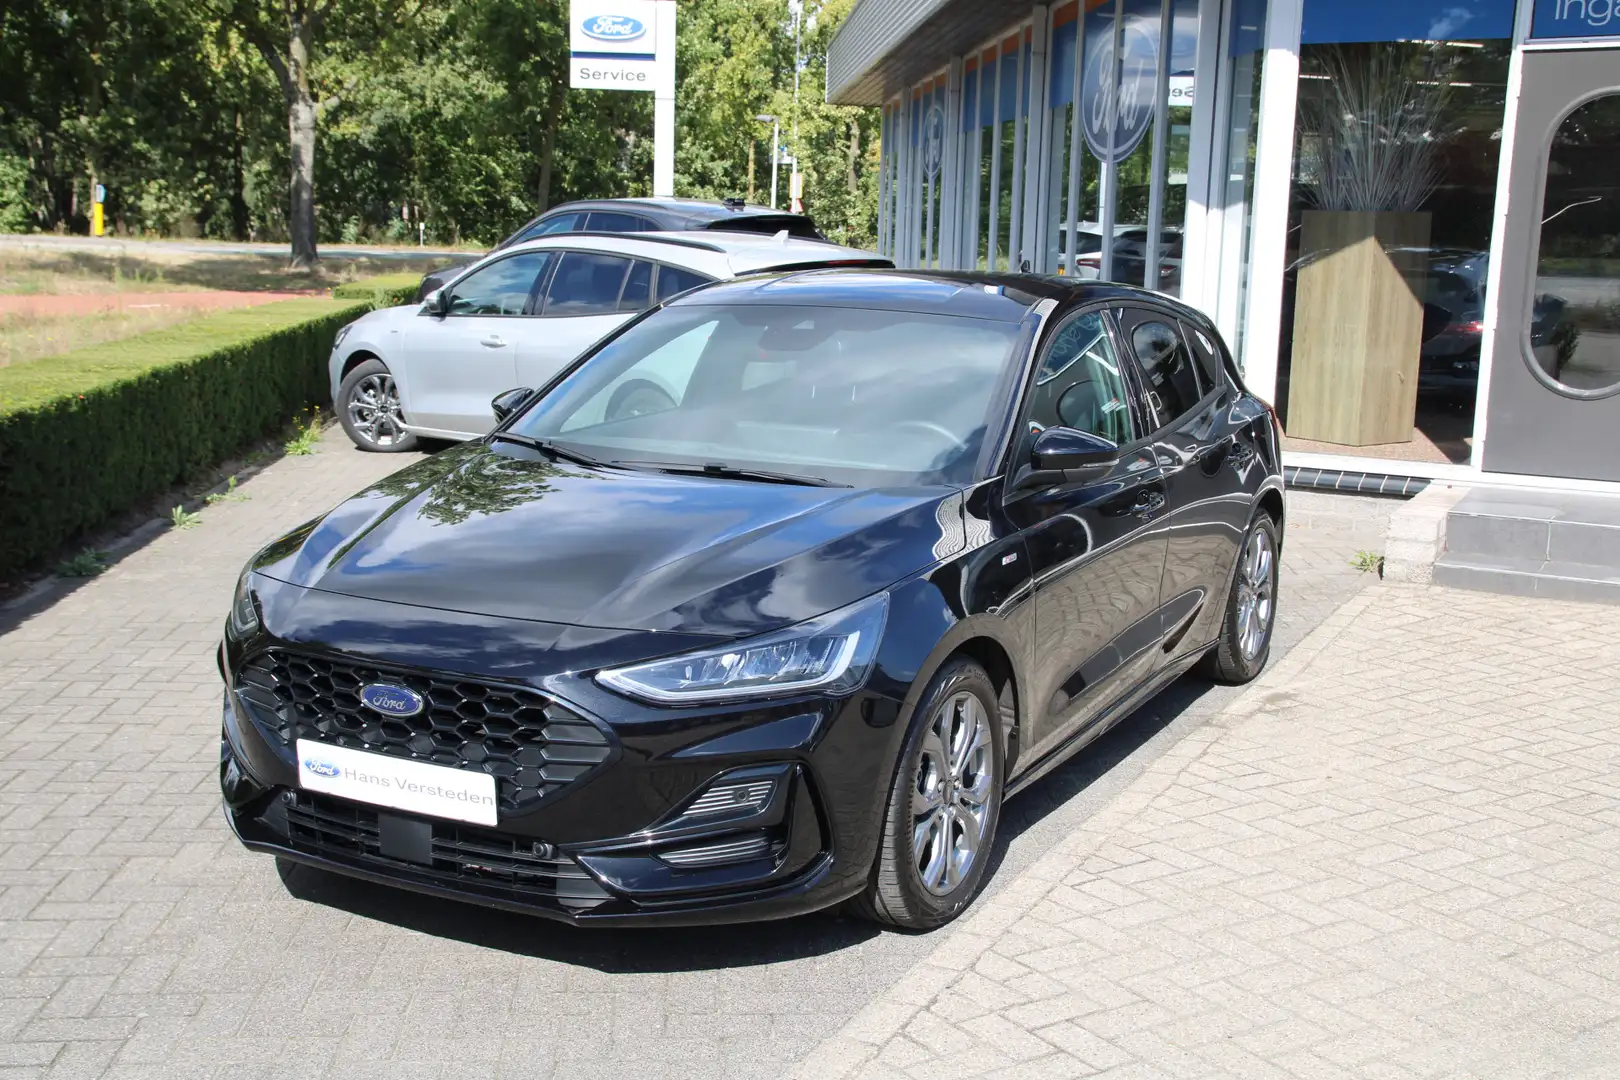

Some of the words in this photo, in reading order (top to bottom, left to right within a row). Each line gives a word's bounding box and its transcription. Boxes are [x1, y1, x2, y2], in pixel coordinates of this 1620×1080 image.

[592, 16, 634, 35] Ford
[579, 67, 646, 82] Service
[372, 689, 406, 711] Ford
[309, 758, 336, 777] Ford
[344, 767, 391, 788] Hans
[394, 776, 494, 806] Versteden
